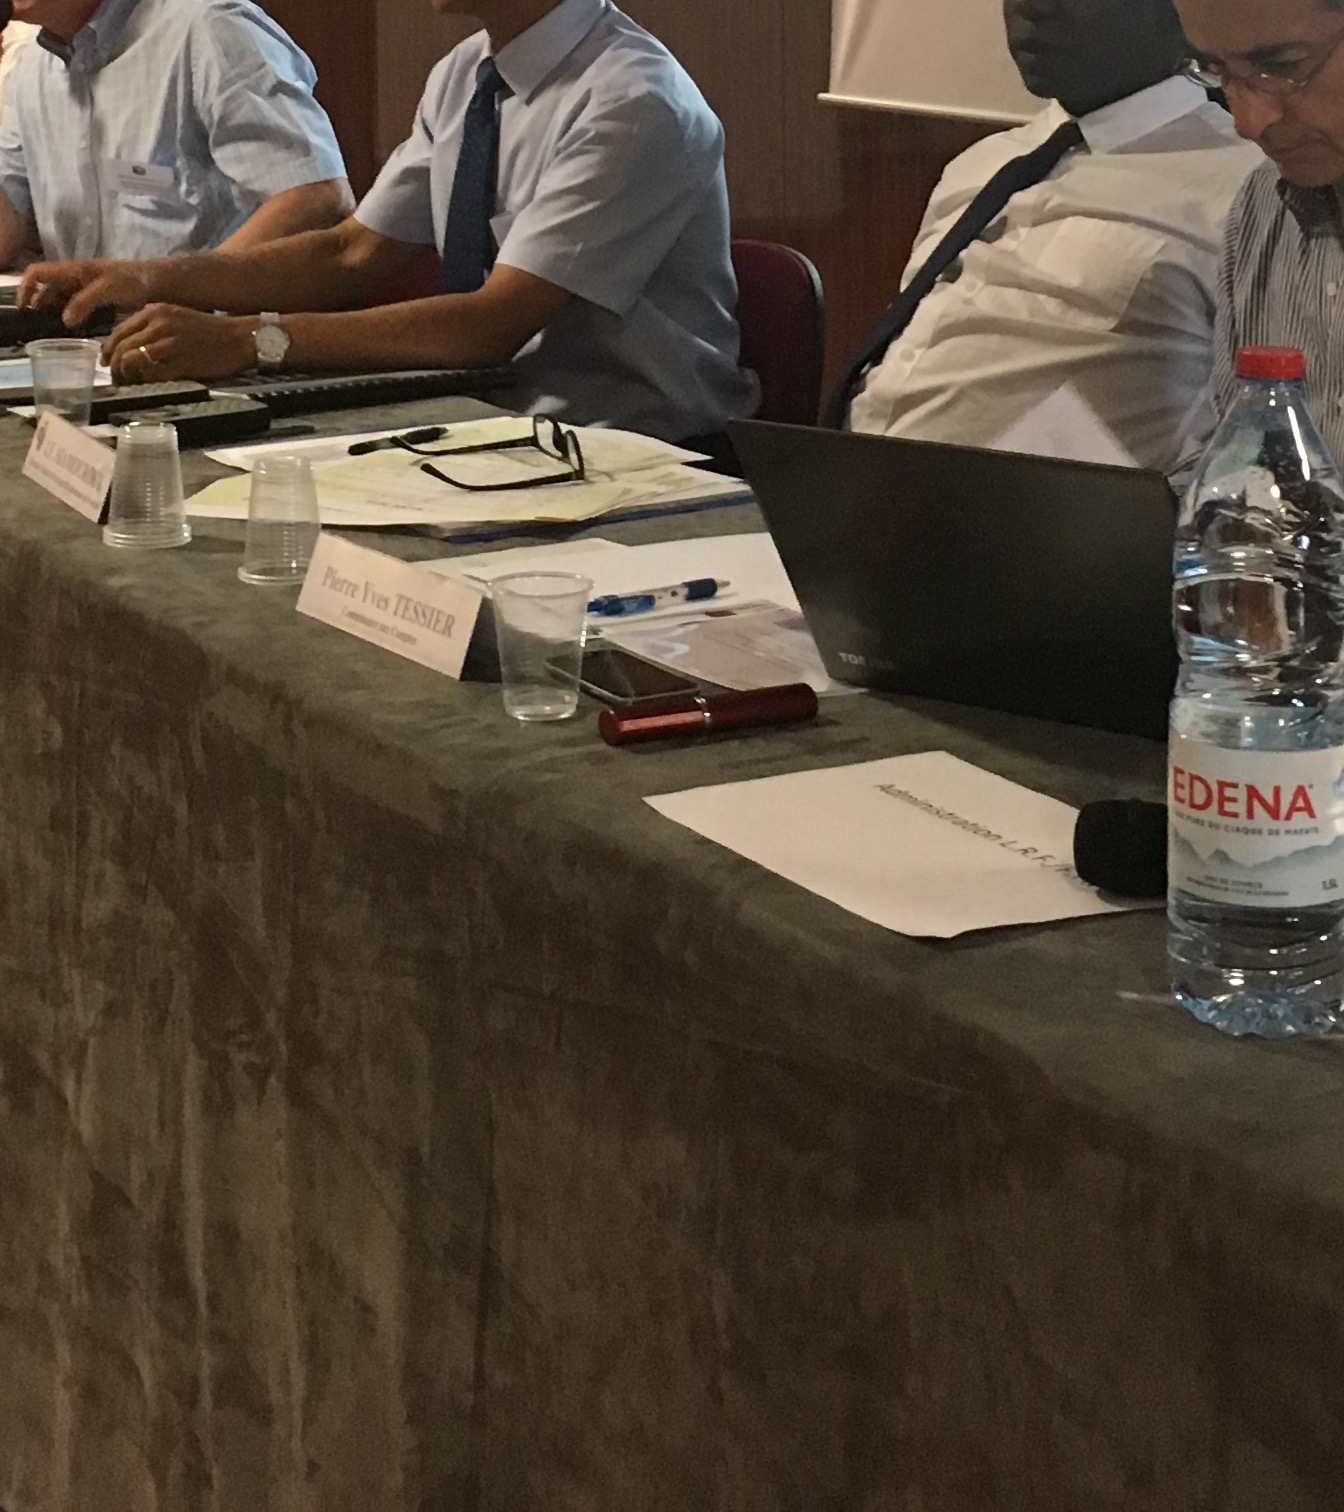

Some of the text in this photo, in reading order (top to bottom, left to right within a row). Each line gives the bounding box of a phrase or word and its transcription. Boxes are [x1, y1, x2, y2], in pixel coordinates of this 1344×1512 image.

[321, 566, 359, 600] Pierre
[362, 581, 391, 613] Yves
[393, 592, 456, 638] TESSIER
[1173, 765, 1317, 822] EDENA
